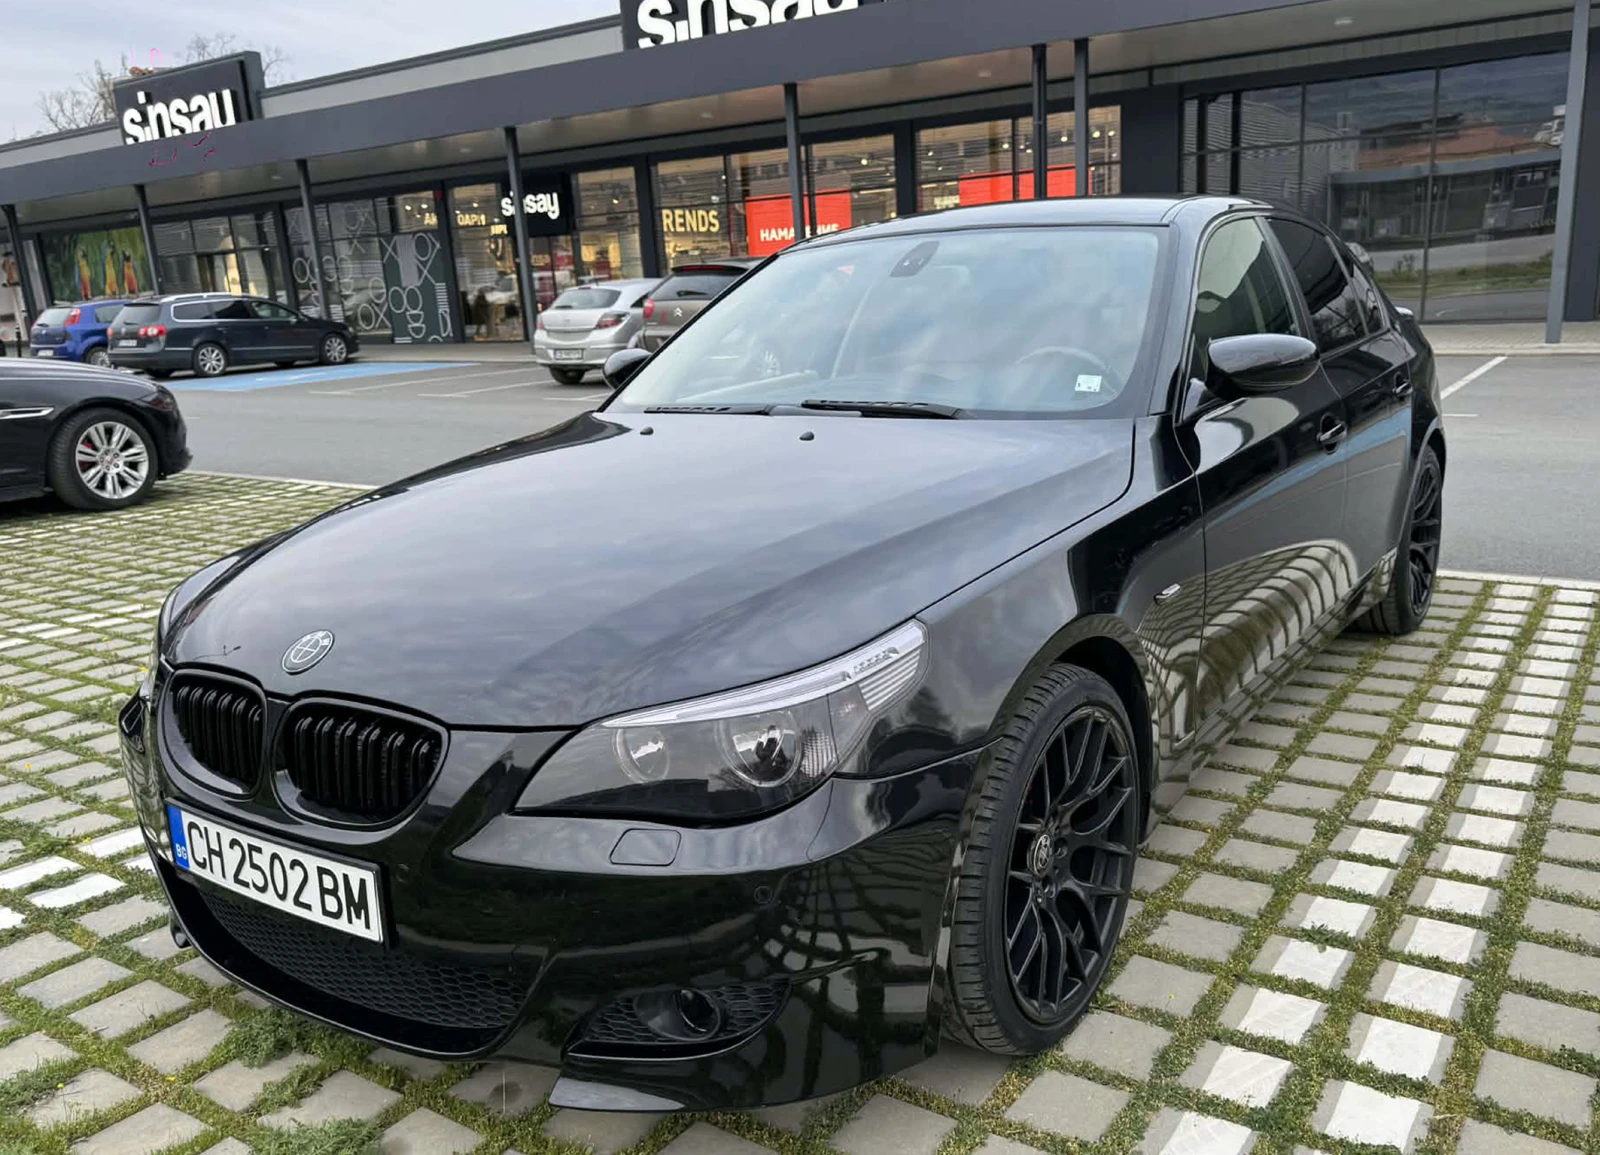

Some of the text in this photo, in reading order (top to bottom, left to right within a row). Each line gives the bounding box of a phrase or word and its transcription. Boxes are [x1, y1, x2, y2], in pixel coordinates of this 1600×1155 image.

[661, 208, 720, 233] RENDS
[175, 844, 188, 860] BG
[229, 838, 313, 912] 2502
